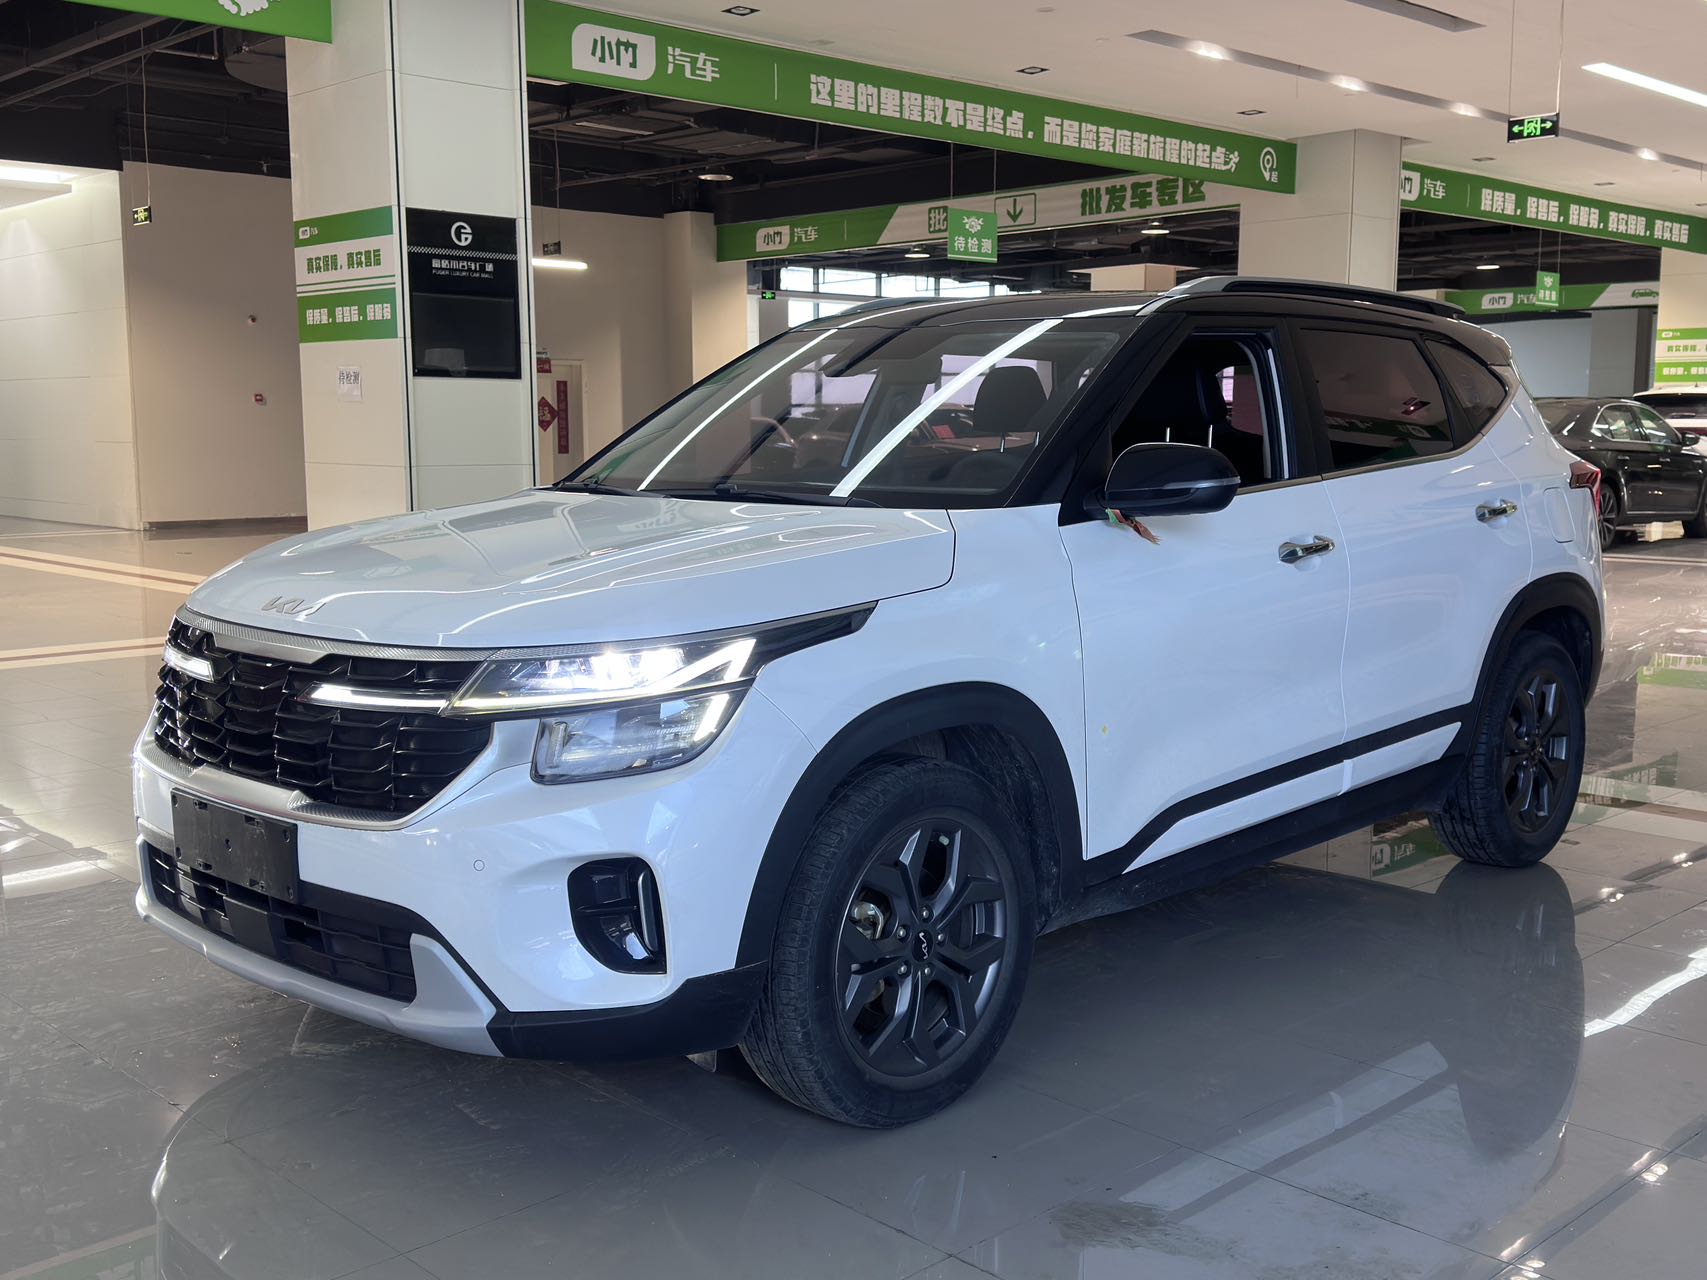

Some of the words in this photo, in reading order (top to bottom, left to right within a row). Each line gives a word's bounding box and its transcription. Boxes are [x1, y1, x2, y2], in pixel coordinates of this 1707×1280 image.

[590, 35, 639, 69] 小竹
[667, 46, 721, 83] 汽车
[1080, 177, 1206, 217] 批发车专区
[1423, 178, 1447, 200] 汽车
[794, 226, 819, 243] 汽车
[954, 235, 993, 255] 待检测
